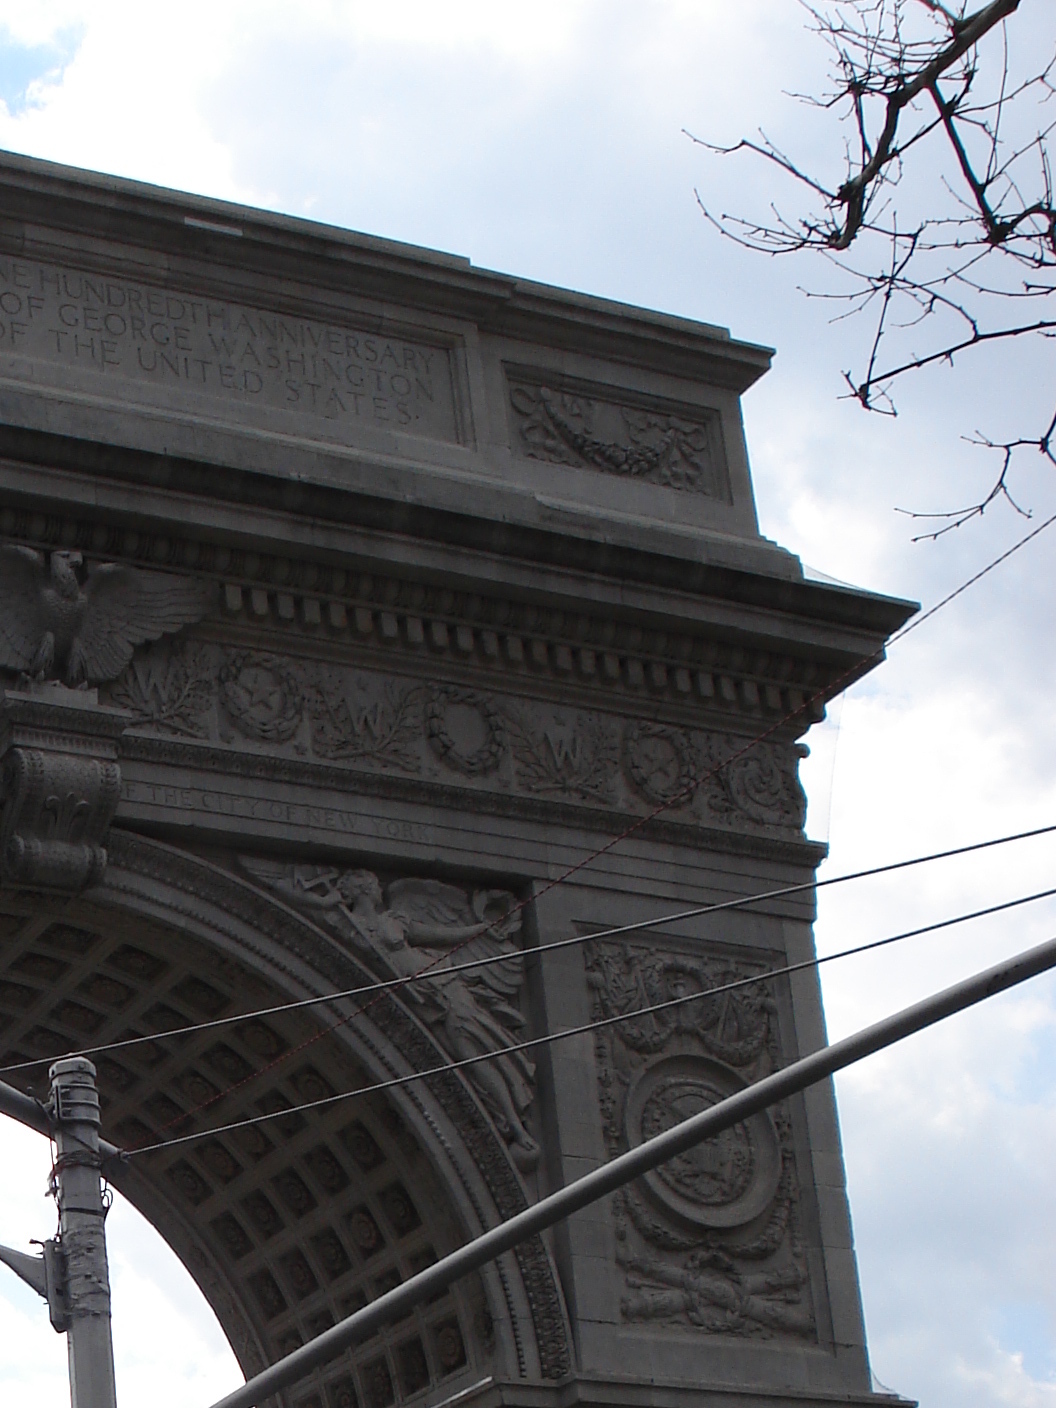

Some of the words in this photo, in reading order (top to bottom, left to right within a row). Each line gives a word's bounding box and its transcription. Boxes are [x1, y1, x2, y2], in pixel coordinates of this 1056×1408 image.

[0, 292, 45, 318] OF
[59, 304, 192, 351] GEORGE
[208, 332, 434, 402] WASHINGTON
[40, 269, 226, 331] HUNDREDTH
[237, 314, 434, 374] ANNIVERSARY
[48, 329, 120, 366] THE
[137, 347, 263, 393] UNITED
